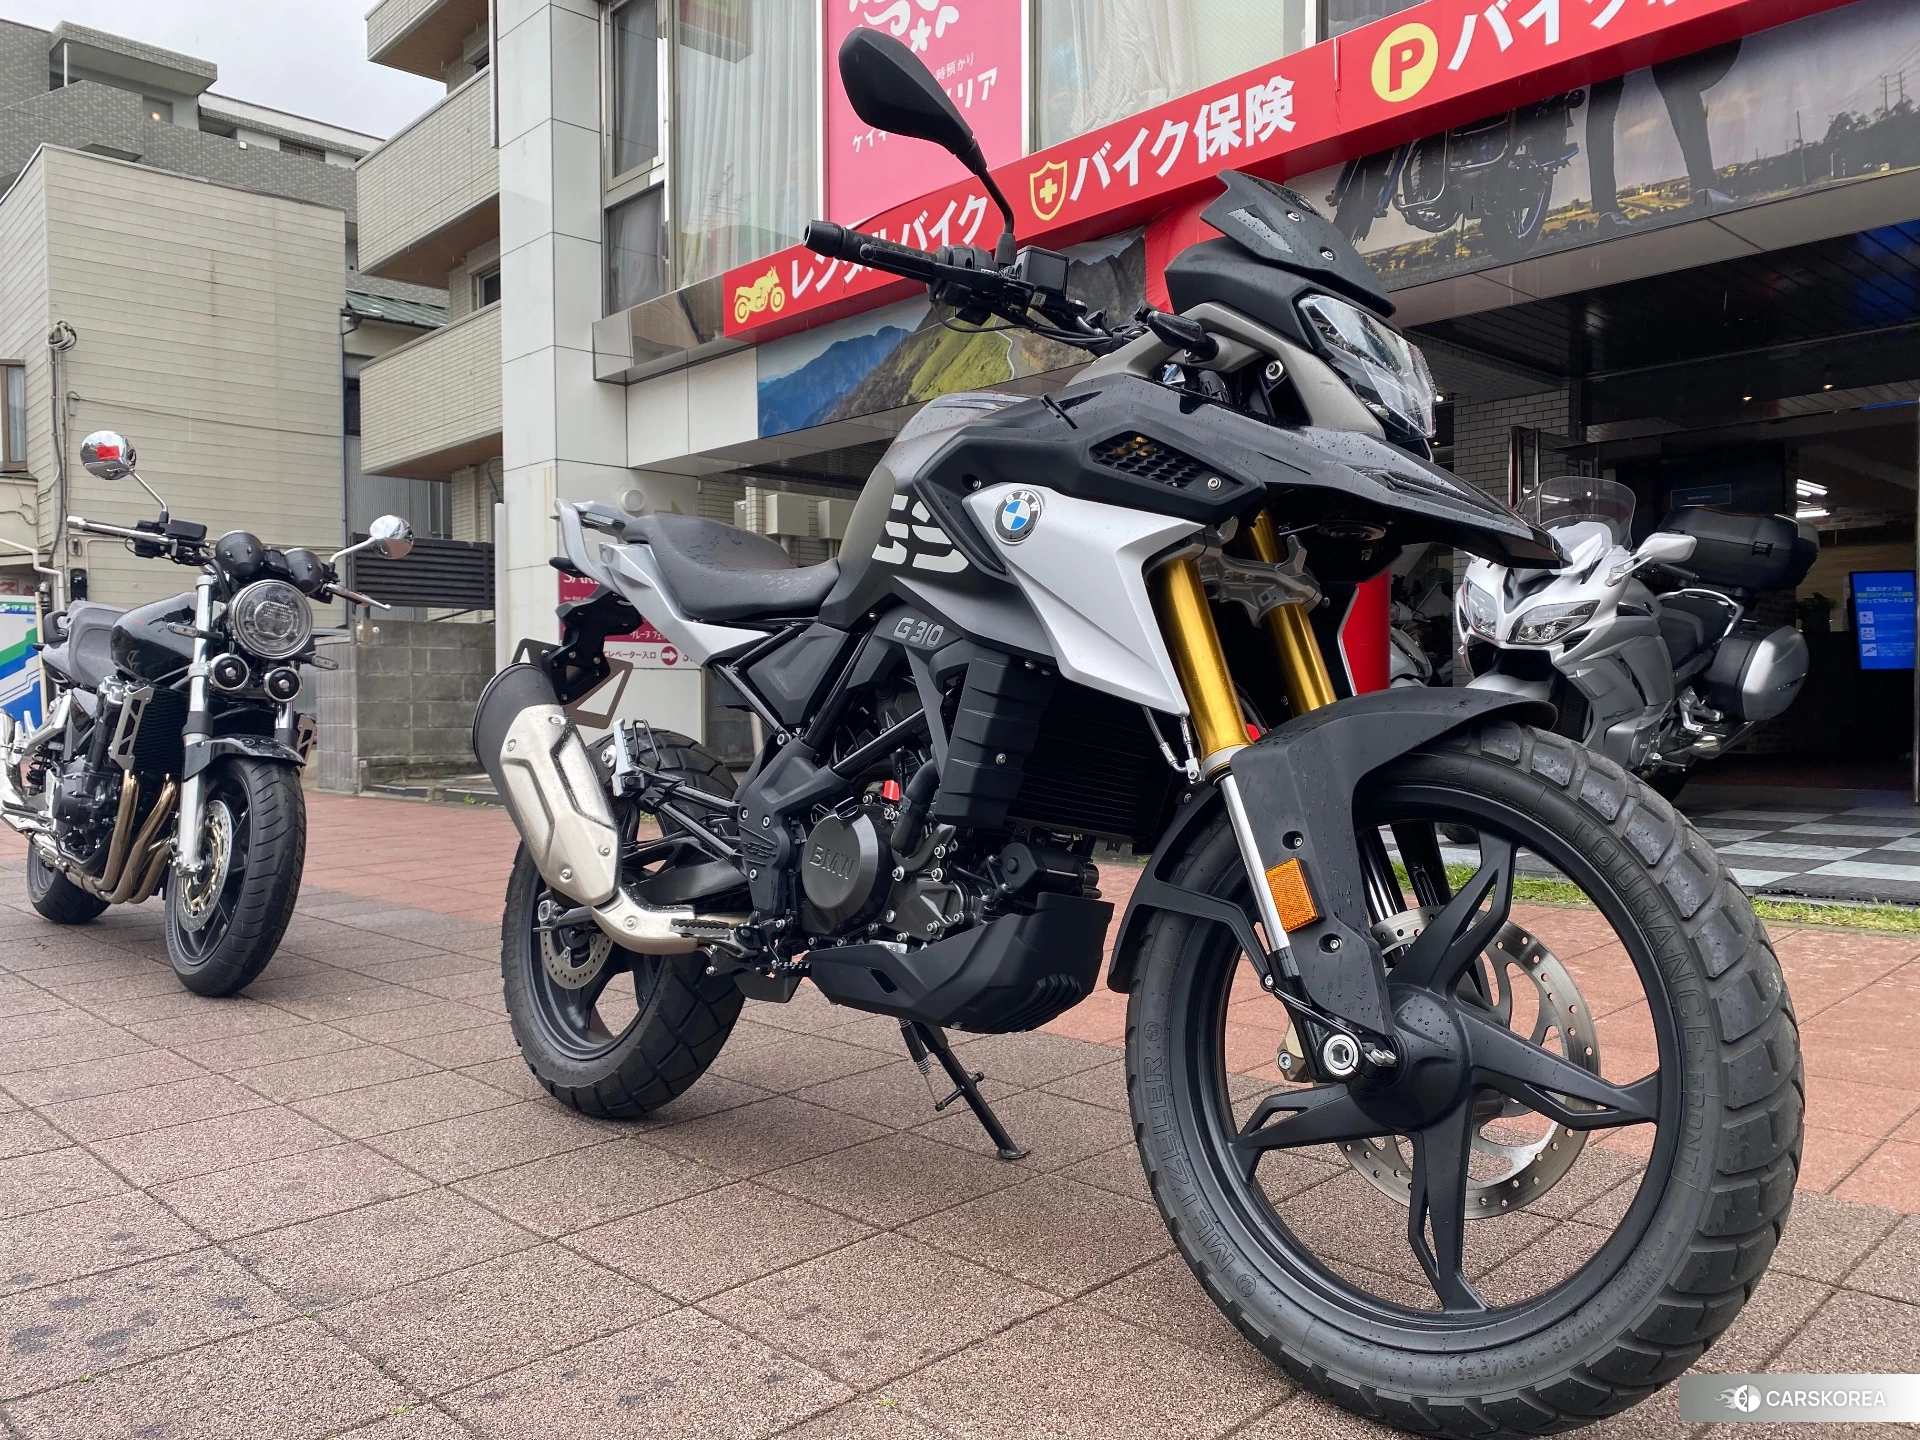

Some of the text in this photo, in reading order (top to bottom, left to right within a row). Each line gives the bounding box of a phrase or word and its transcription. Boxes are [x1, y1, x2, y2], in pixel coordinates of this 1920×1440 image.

[936, 53, 974, 80] 時預かり
[946, 67, 998, 108] リア
[1070, 75, 1297, 201] バイク保険
[792, 194, 988, 299] レンバイク
[809, 843, 856, 880] BMW
[1573, 811, 1714, 1052] TOURANCE
[1143, 1055, 1236, 1272] METZELER
